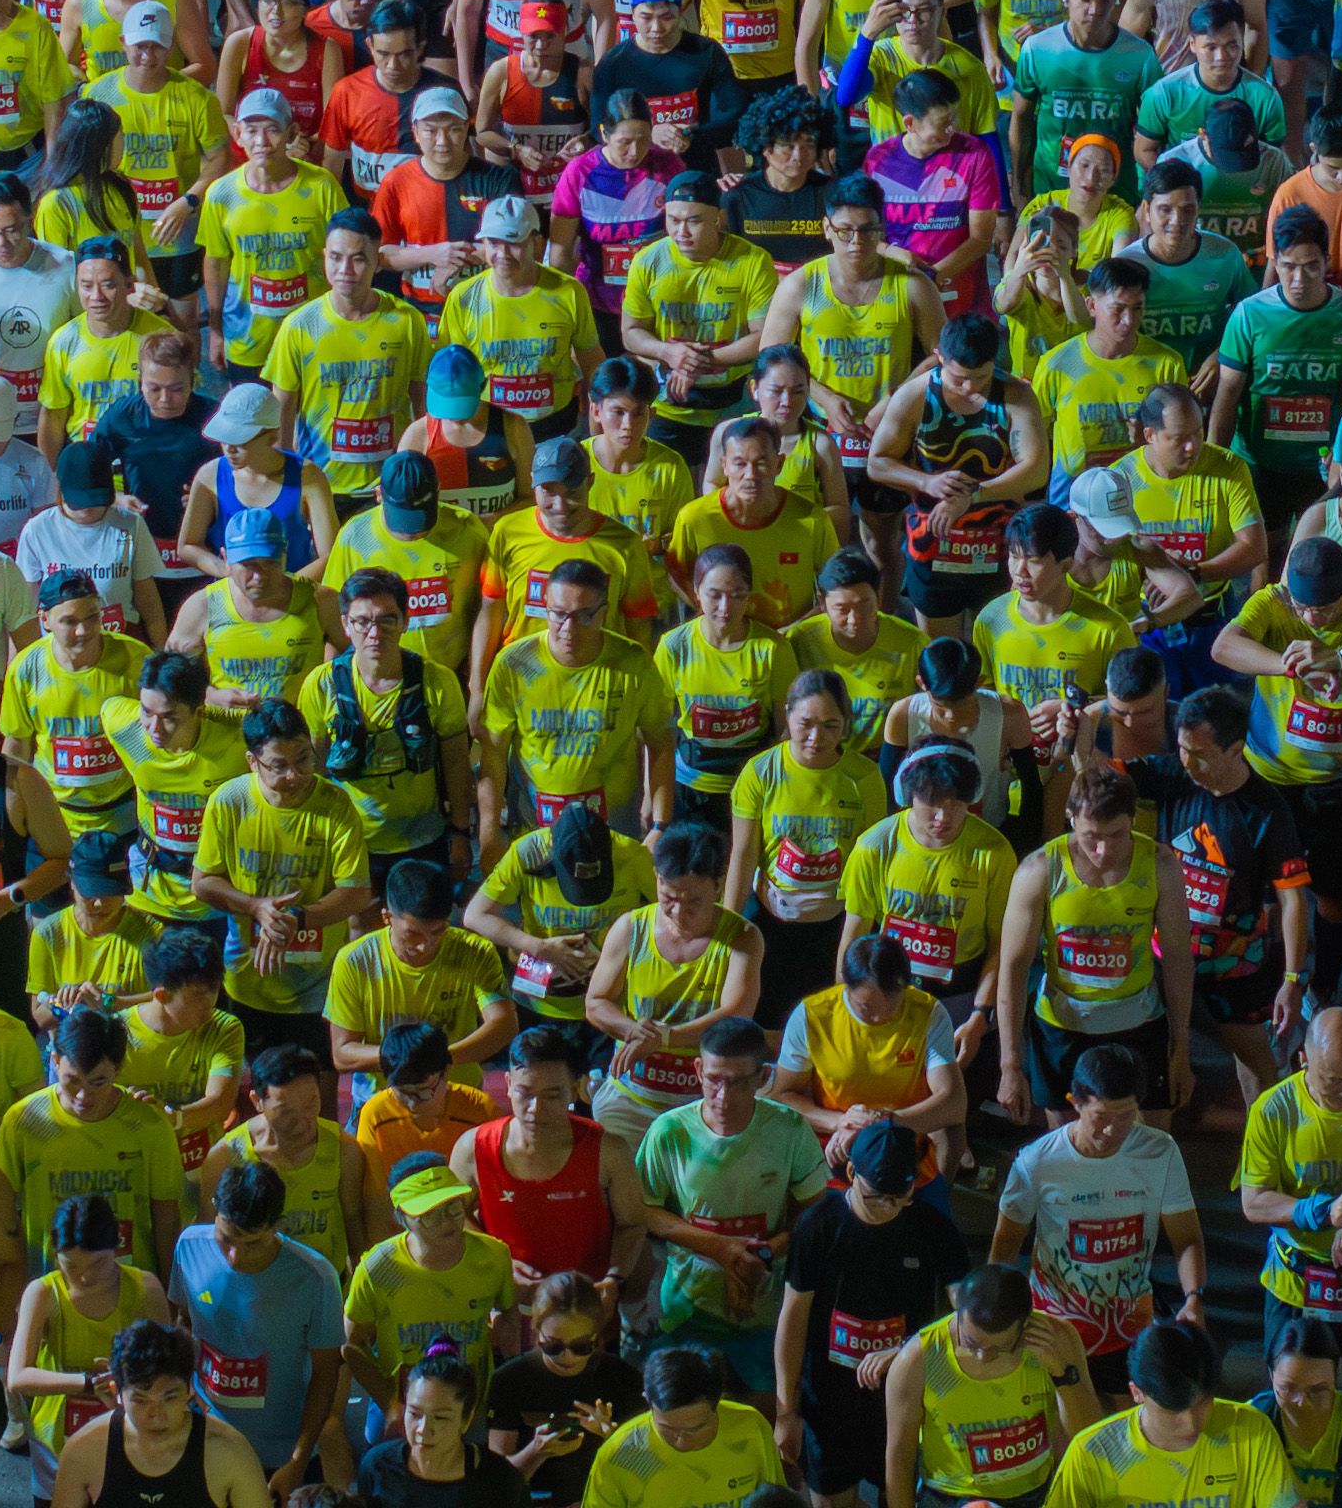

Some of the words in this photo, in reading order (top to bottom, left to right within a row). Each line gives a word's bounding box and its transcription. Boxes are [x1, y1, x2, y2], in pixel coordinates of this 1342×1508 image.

[737, 23, 775, 36] 80001
[657, 108, 693, 122] 82627
[886, 203, 935, 224] MAF
[266, 287, 304, 301] 84018
[835, 358, 874, 376] 2026
[506, 387, 550, 402] 80709
[1285, 410, 1324, 424] 81223
[350, 433, 389, 447] 81296
[950, 542, 997, 556] 80084
[408, 593, 447, 608] 0028
[530, 708, 620, 732] MIDNIGHT
[712, 716, 755, 733] 82376
[73, 751, 116, 767] 81236
[792, 863, 838, 876] 82366
[1076, 953, 1126, 968] 80320
[646, 1066, 697, 1085] 83500
[1093, 1233, 1137, 1254] 81754
[210, 1368, 260, 1390] 83814
[993, 1433, 1044, 1461] 80307
